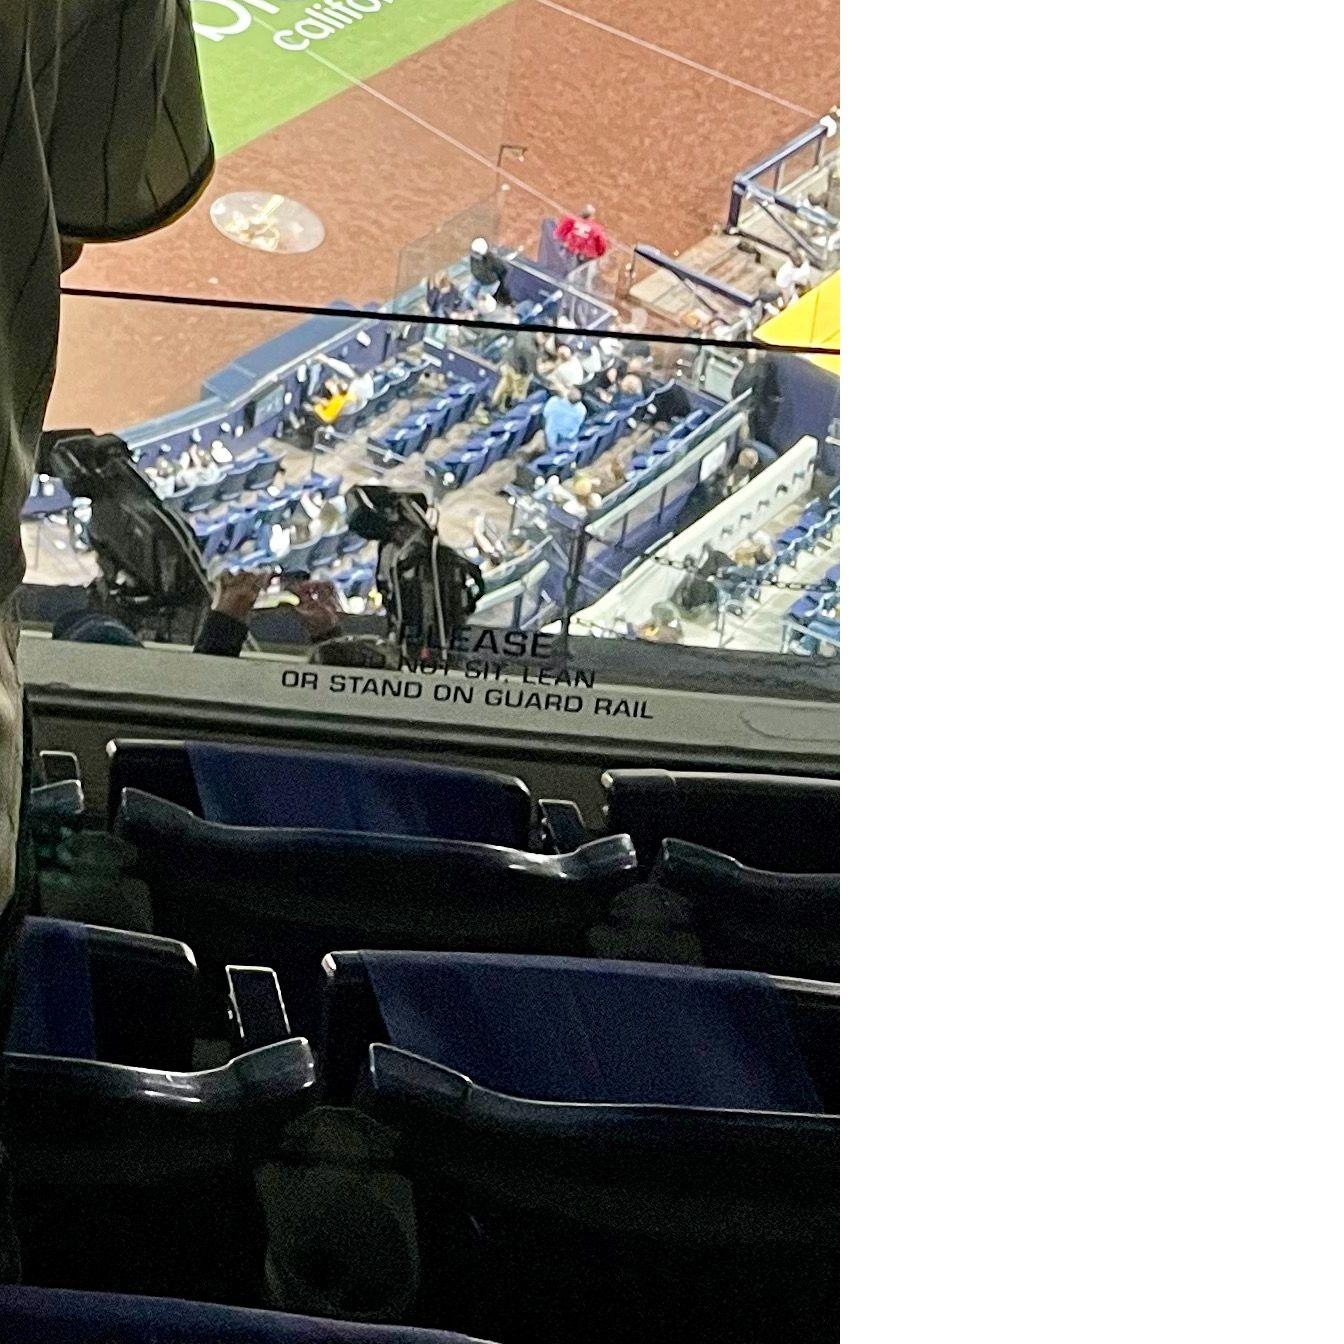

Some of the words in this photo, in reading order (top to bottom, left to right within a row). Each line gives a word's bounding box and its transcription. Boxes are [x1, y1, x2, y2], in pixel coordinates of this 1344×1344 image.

[282, 670, 318, 691] OR
[329, 674, 422, 699] STAND
[434, 684, 473, 705] ON
[485, 689, 583, 713] GUARD
[594, 698, 654, 719] RAIL
[523, 665, 595, 688] LEAN
